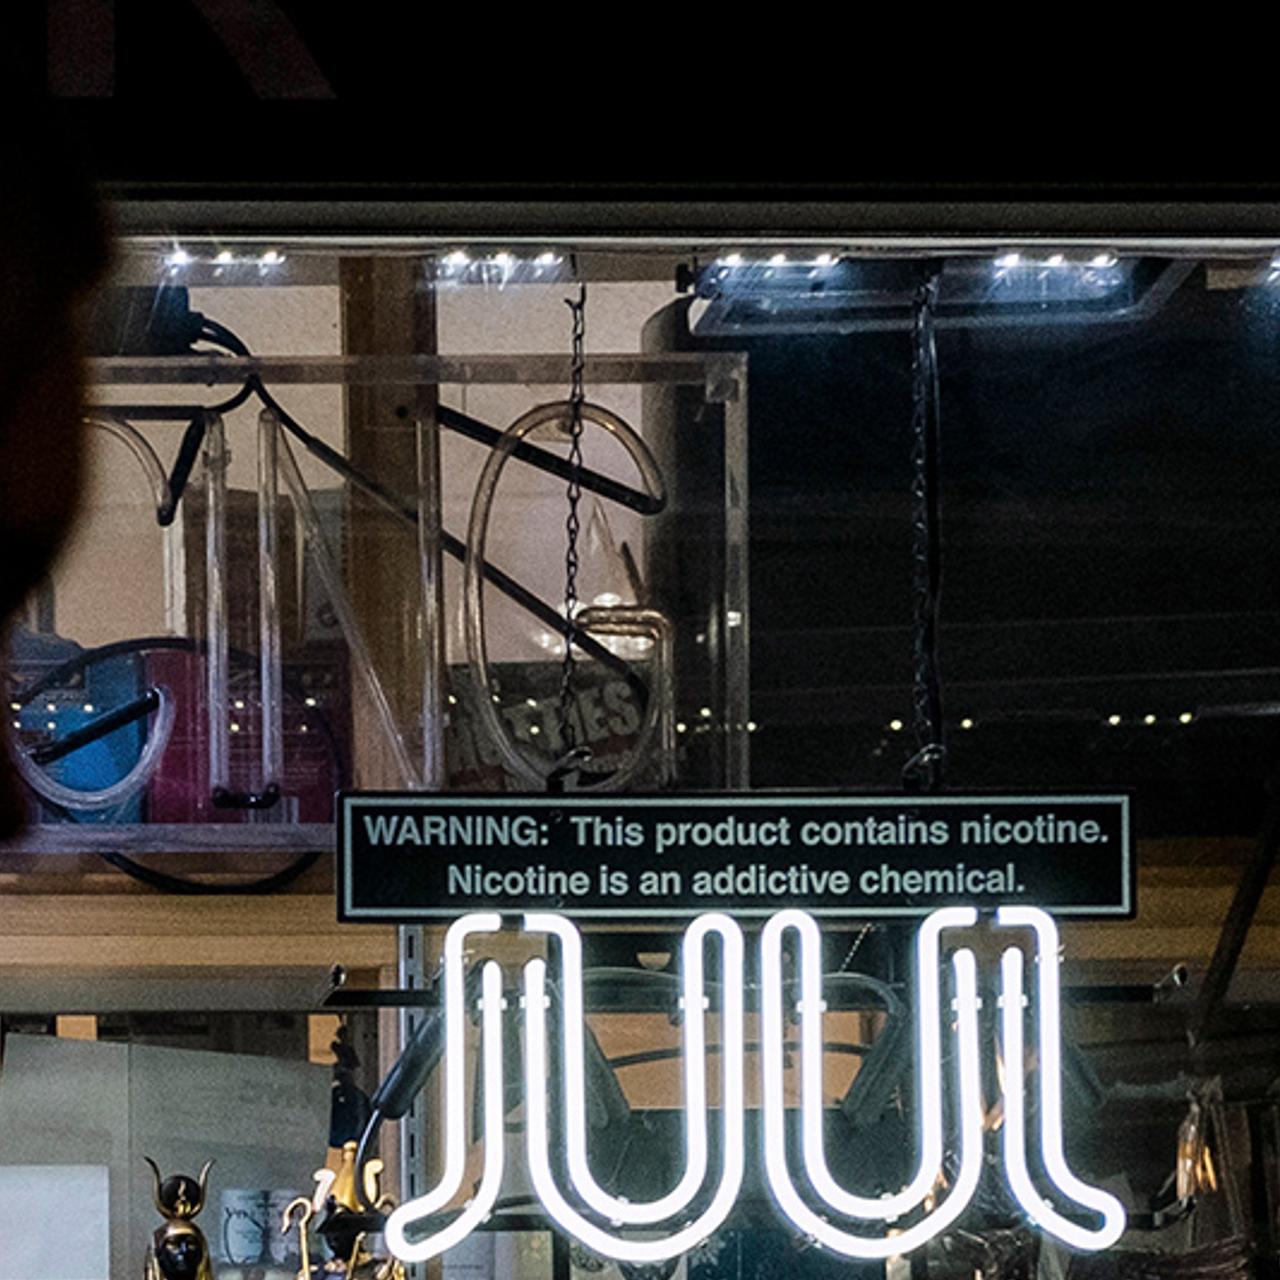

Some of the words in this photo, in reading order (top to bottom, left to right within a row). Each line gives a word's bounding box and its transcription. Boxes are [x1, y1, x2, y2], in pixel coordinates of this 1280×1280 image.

[363, 816, 549, 846] WARNING:
[570, 815, 645, 846] This
[655, 815, 791, 853] product
[800, 814, 950, 846] contains
[961, 813, 1109, 844] nicotine.
[447, 864, 590, 895] Nicotine
[599, 864, 629, 895] is
[639, 872, 681, 895] an
[691, 864, 851, 896] addictive
[860, 862, 1026, 894] chemical.
[384, 906, 1129, 1262] JUUL
